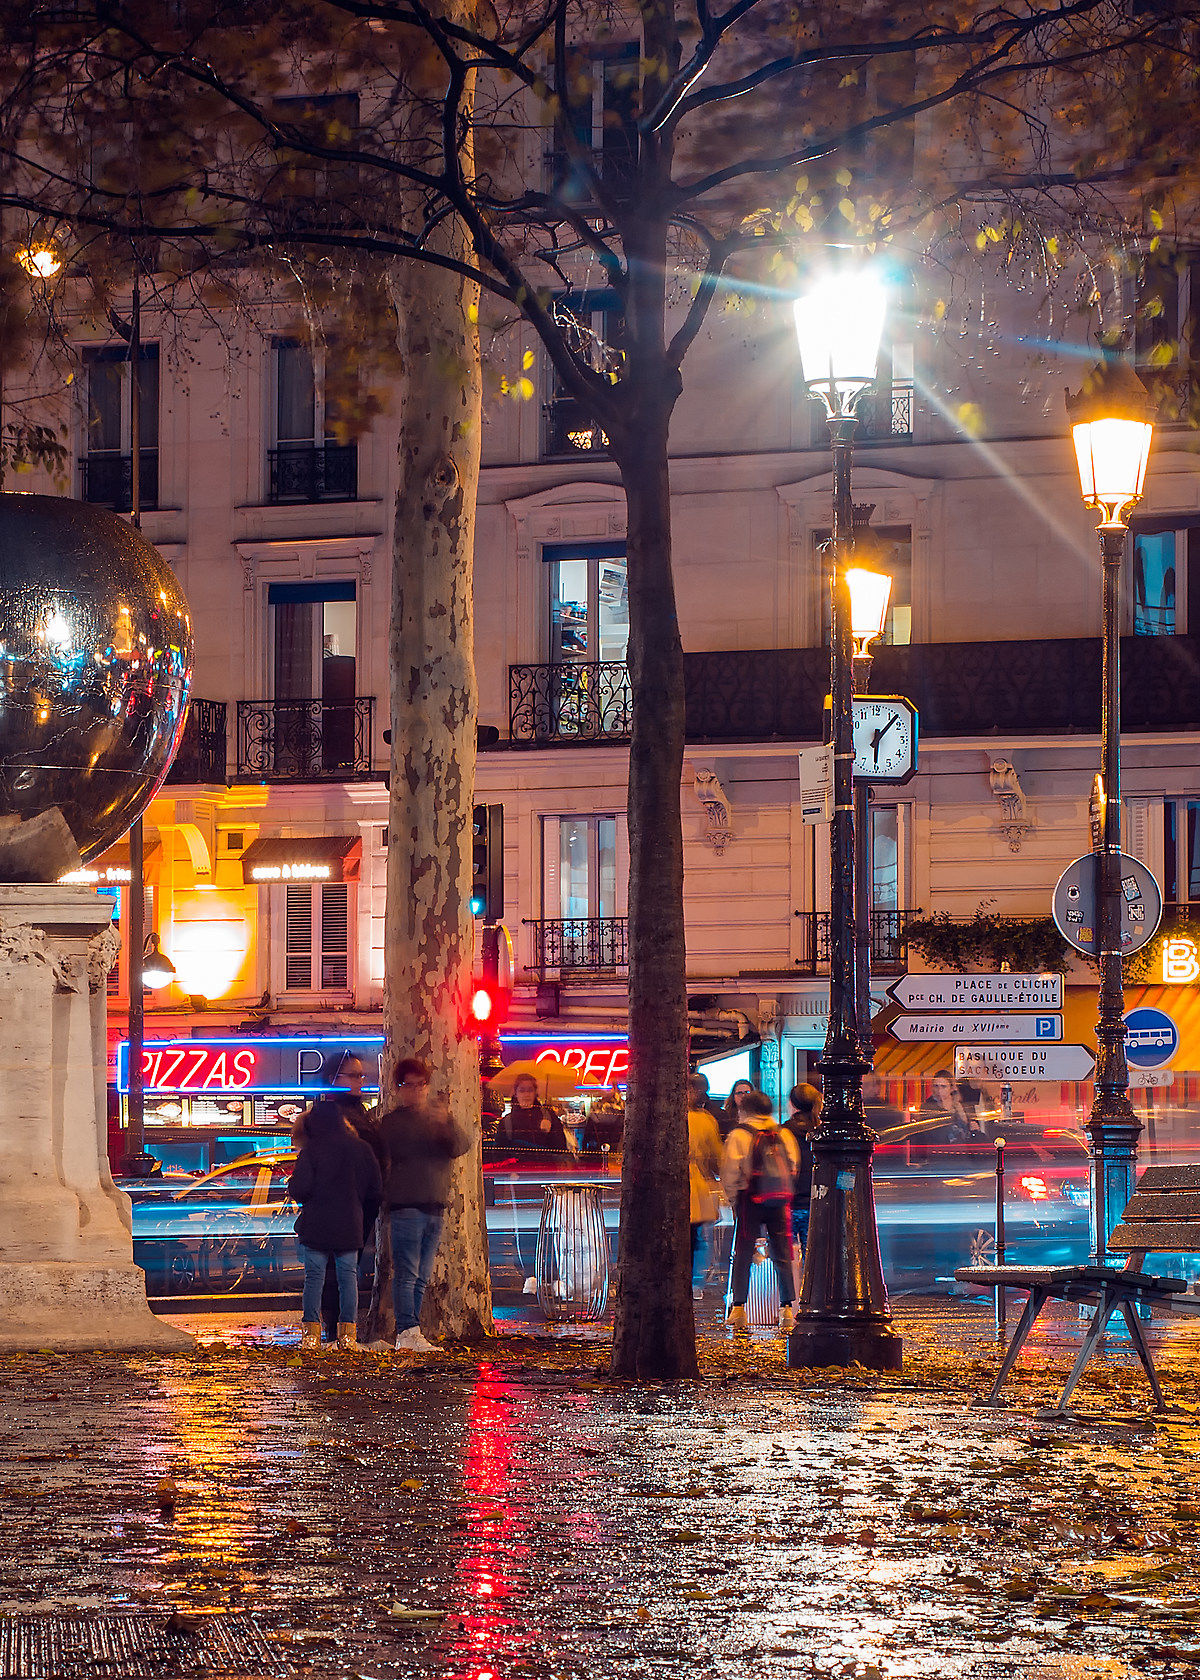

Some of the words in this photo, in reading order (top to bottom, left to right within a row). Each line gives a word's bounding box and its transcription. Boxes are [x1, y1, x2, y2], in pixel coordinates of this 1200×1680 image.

[861, 711, 868, 720] 11
[872, 707, 881, 717] 12
[895, 721, 902, 730] 2
[900, 735, 906, 745] 3
[895, 748, 902, 758] 4
[861, 757, 867, 767] 7
[886, 758, 892, 768] 5
[955, 980, 992, 990] PLACE
[1014, 979, 1058, 990] CLICHY
[929, 994, 946, 1004] CH.
[951, 994, 966, 1004] DE
[971, 991, 1058, 1004] GAULLE-ÉTOILE
[909, 1023, 945, 1034] Mairie
[952, 1023, 965, 1034] du
[959, 1051, 1025, 1062] BASILIQUE
[1032, 1051, 1048, 1062] DU
[959, 1063, 1046, 1076] SACRÉ-COEUR
